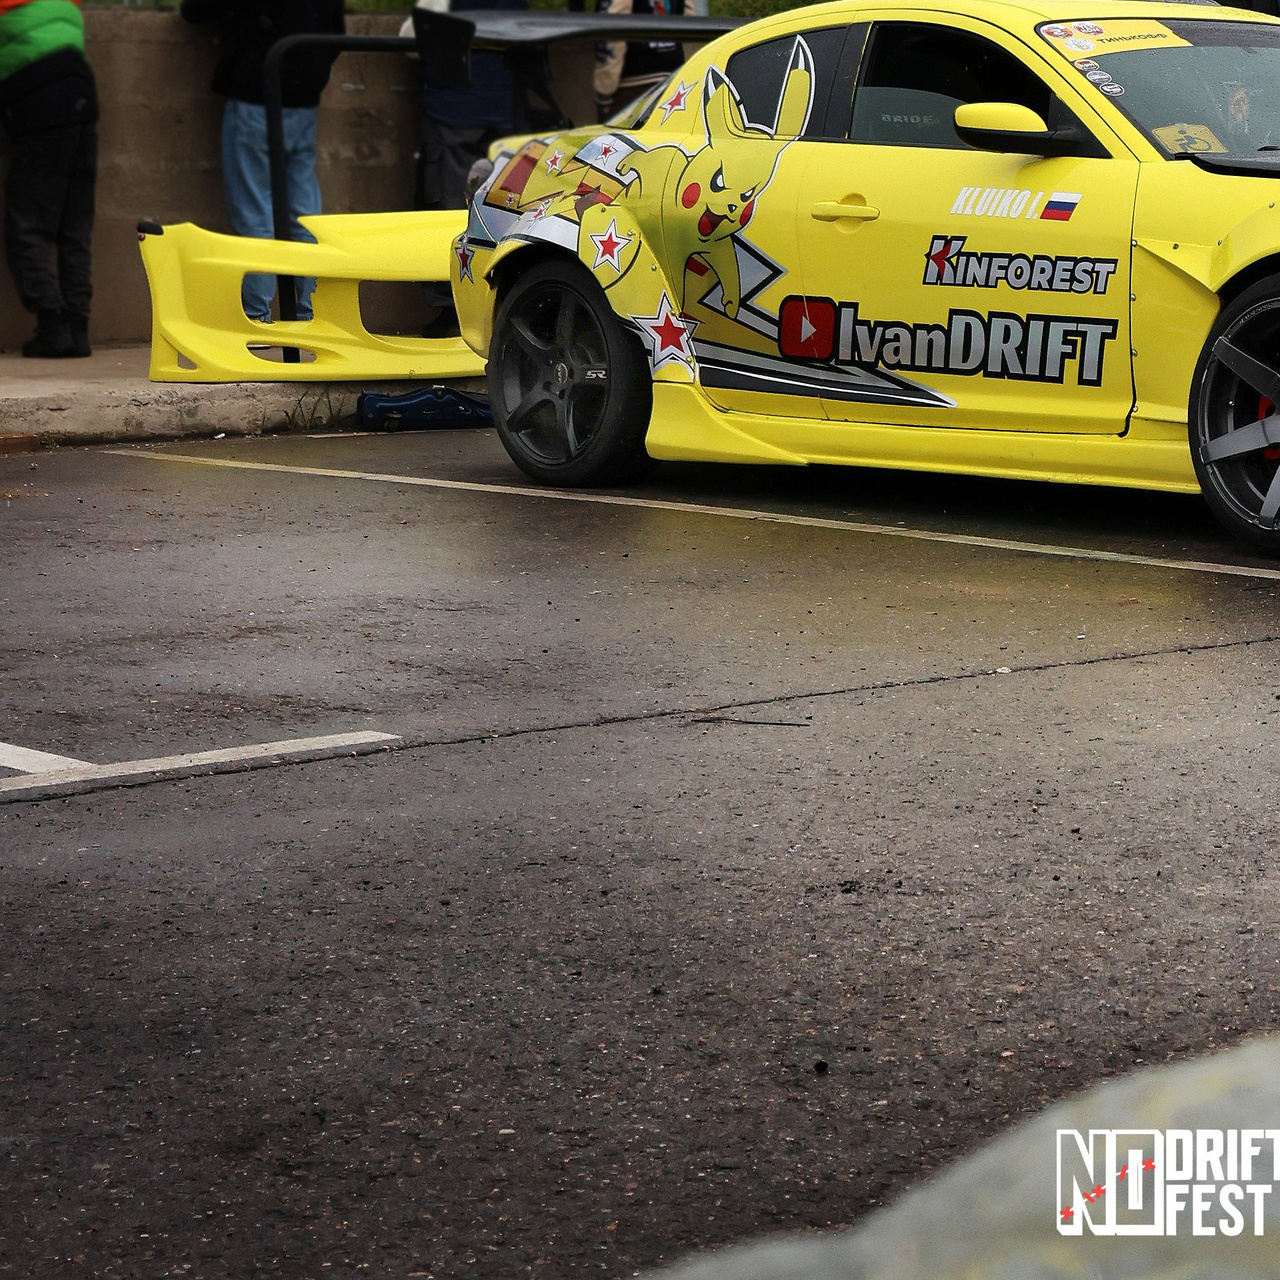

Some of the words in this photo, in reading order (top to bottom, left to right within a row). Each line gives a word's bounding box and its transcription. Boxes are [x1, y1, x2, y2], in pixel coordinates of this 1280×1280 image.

[950, 185, 1031, 219] KLUIKO
[923, 235, 1118, 294] KINFOREST
[836, 302, 1119, 387] IvanDRIFT
